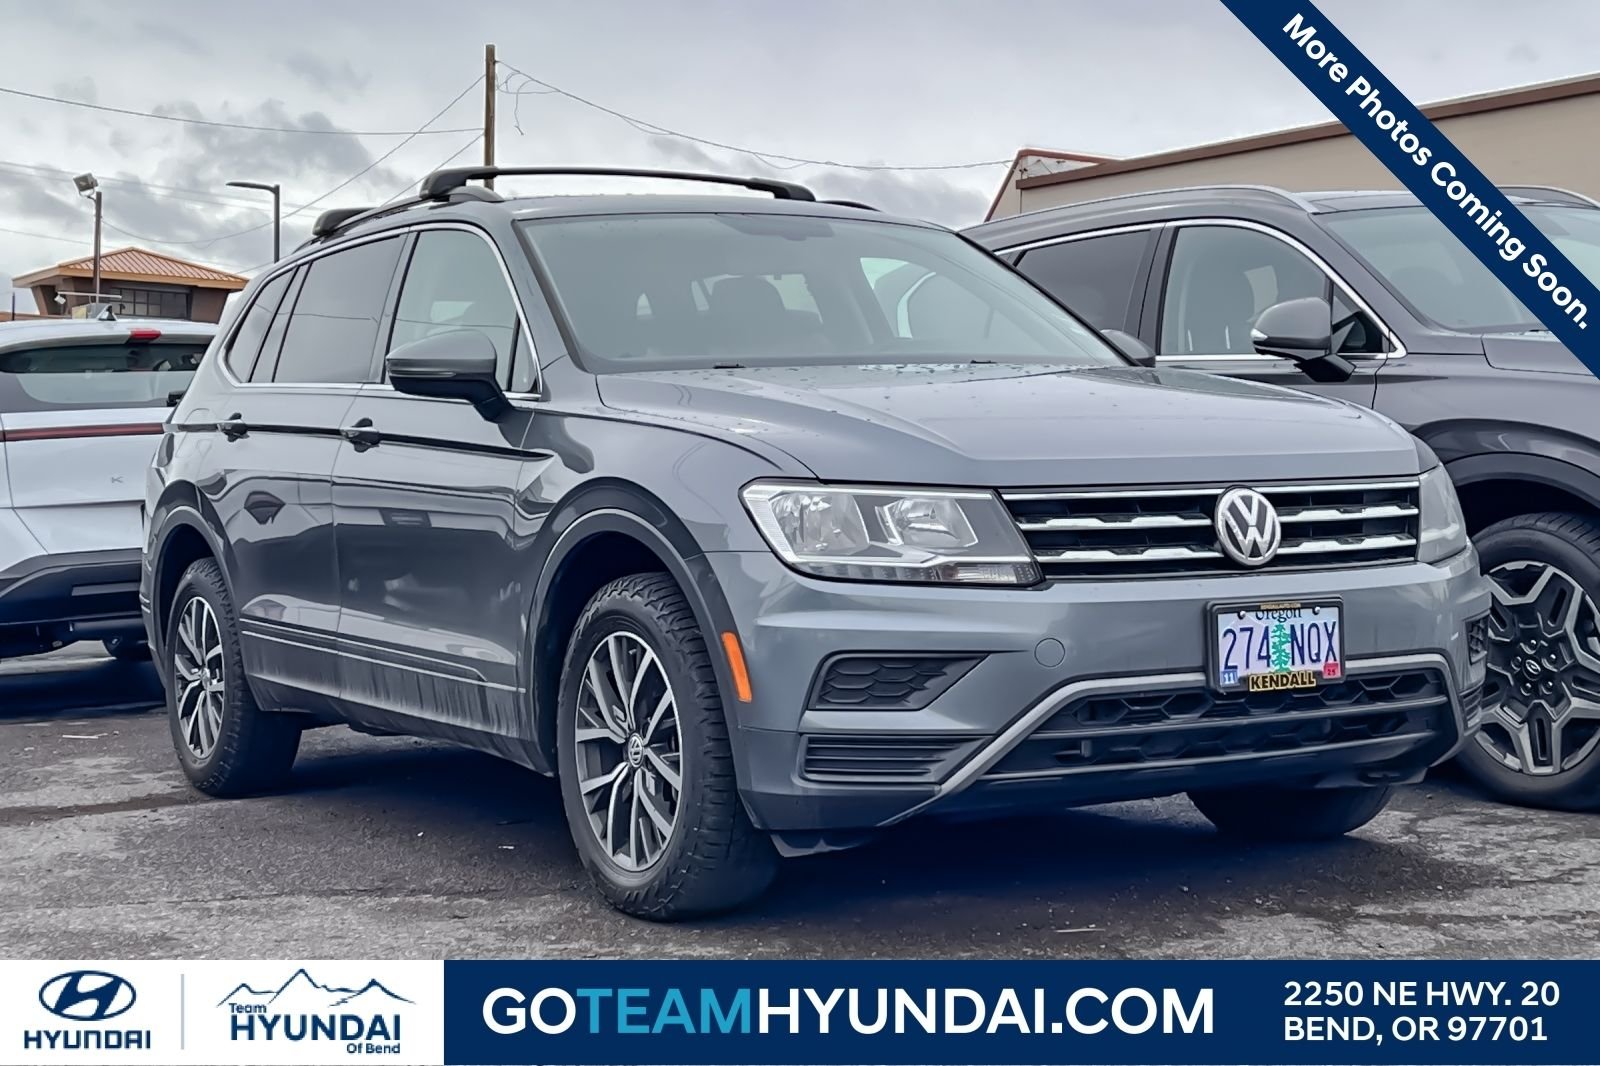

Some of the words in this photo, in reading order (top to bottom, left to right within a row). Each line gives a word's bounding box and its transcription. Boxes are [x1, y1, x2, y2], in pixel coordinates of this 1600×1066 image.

[1223, 626, 1271, 670] 274
[1290, 621, 1337, 666] NQX
[1250, 672, 1315, 690] KENDALL
